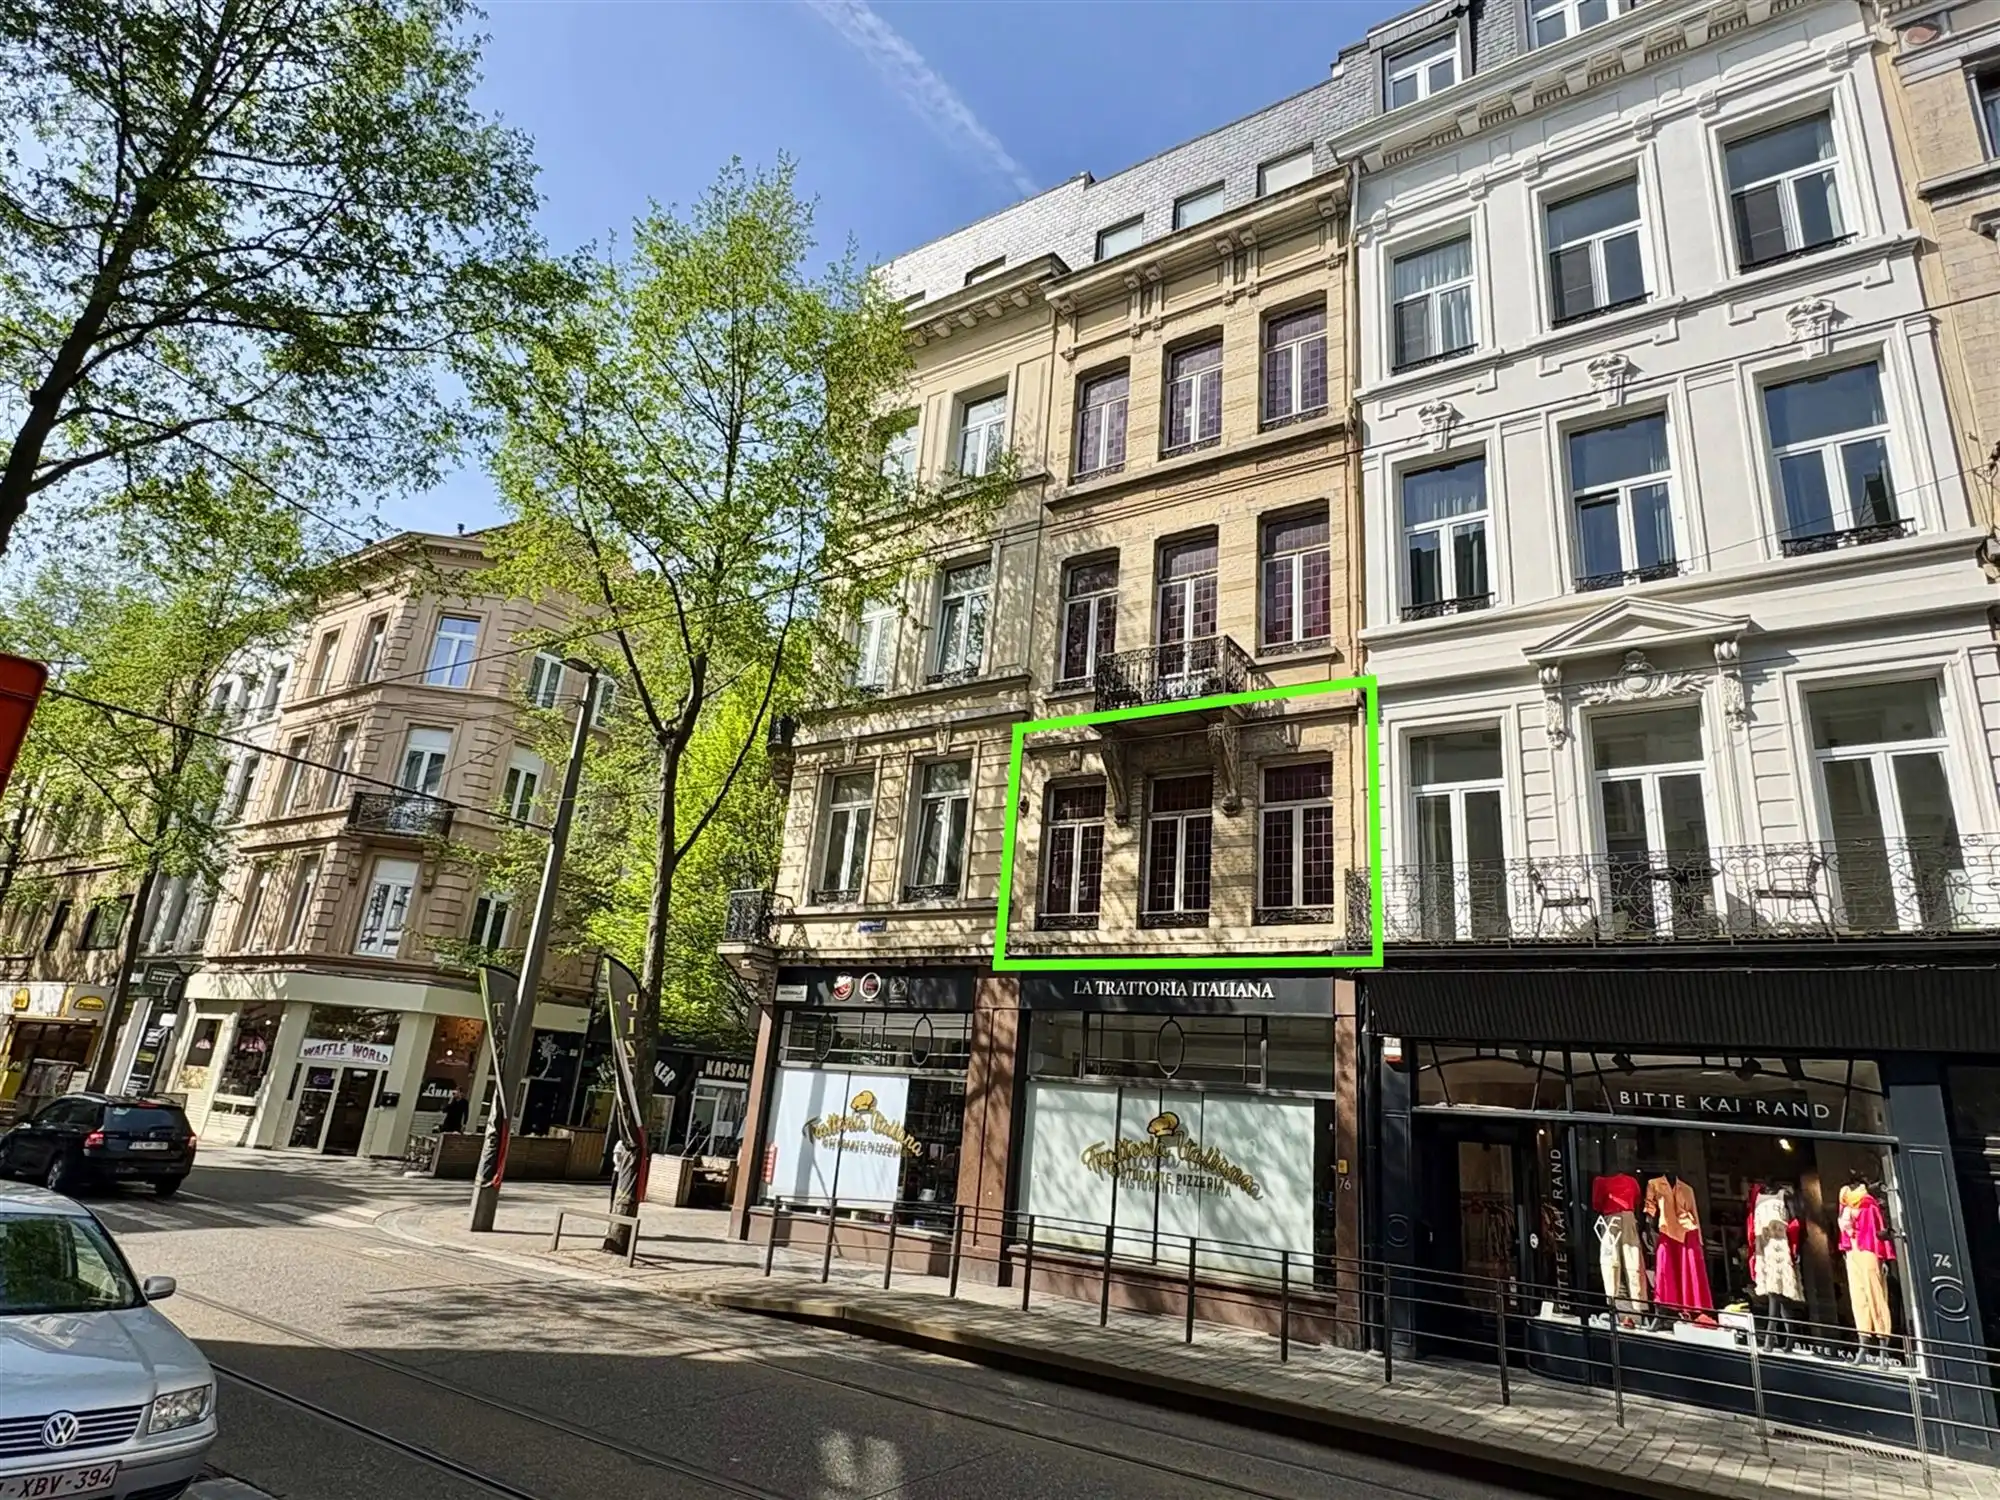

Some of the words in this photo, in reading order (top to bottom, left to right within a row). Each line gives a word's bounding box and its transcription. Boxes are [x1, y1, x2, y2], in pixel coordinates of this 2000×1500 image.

[1073, 980, 1092, 995] LA
[1095, 980, 1188, 997] TRATTORIA
[1192, 982, 1275, 998] ITALIANA
[303, 1043, 347, 1057] WAFFLE
[352, 1043, 389, 1064] WORLD
[1619, 1091, 1687, 1109] BITTE
[1700, 1096, 1741, 1113] KAI
[1756, 1100, 1830, 1119] RAND
[1339, 1177, 1352, 1190] 76
[1550, 1149, 1565, 1200] RAND
[1932, 1253, 1952, 1268] 74
